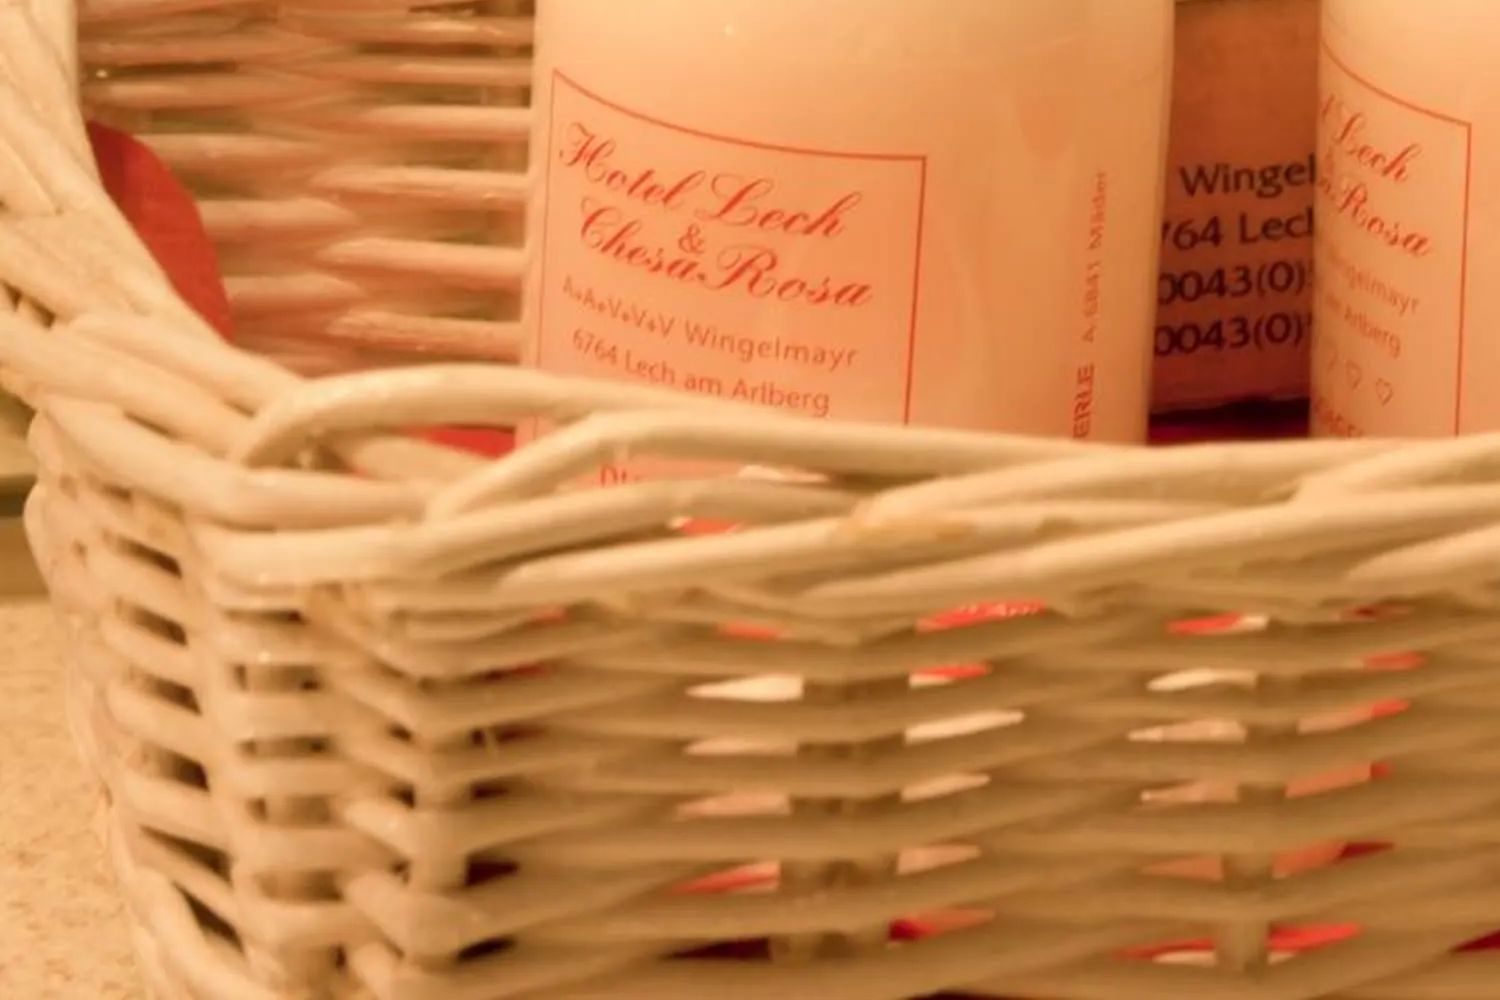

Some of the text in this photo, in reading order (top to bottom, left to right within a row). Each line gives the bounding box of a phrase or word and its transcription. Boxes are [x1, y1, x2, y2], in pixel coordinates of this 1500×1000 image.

[558, 122, 863, 239] Hotel Lech
[1178, 151, 1316, 199] Wingel
[579, 196, 874, 307] Chesa Rosa
[678, 223, 706, 255] &
[1157, 258, 1314, 306] 0043(0)
[684, 319, 859, 374] Wingelmayr
[1153, 311, 1313, 358] 0043(0)
[571, 327, 832, 419] 6764 Lech am Arlberg
